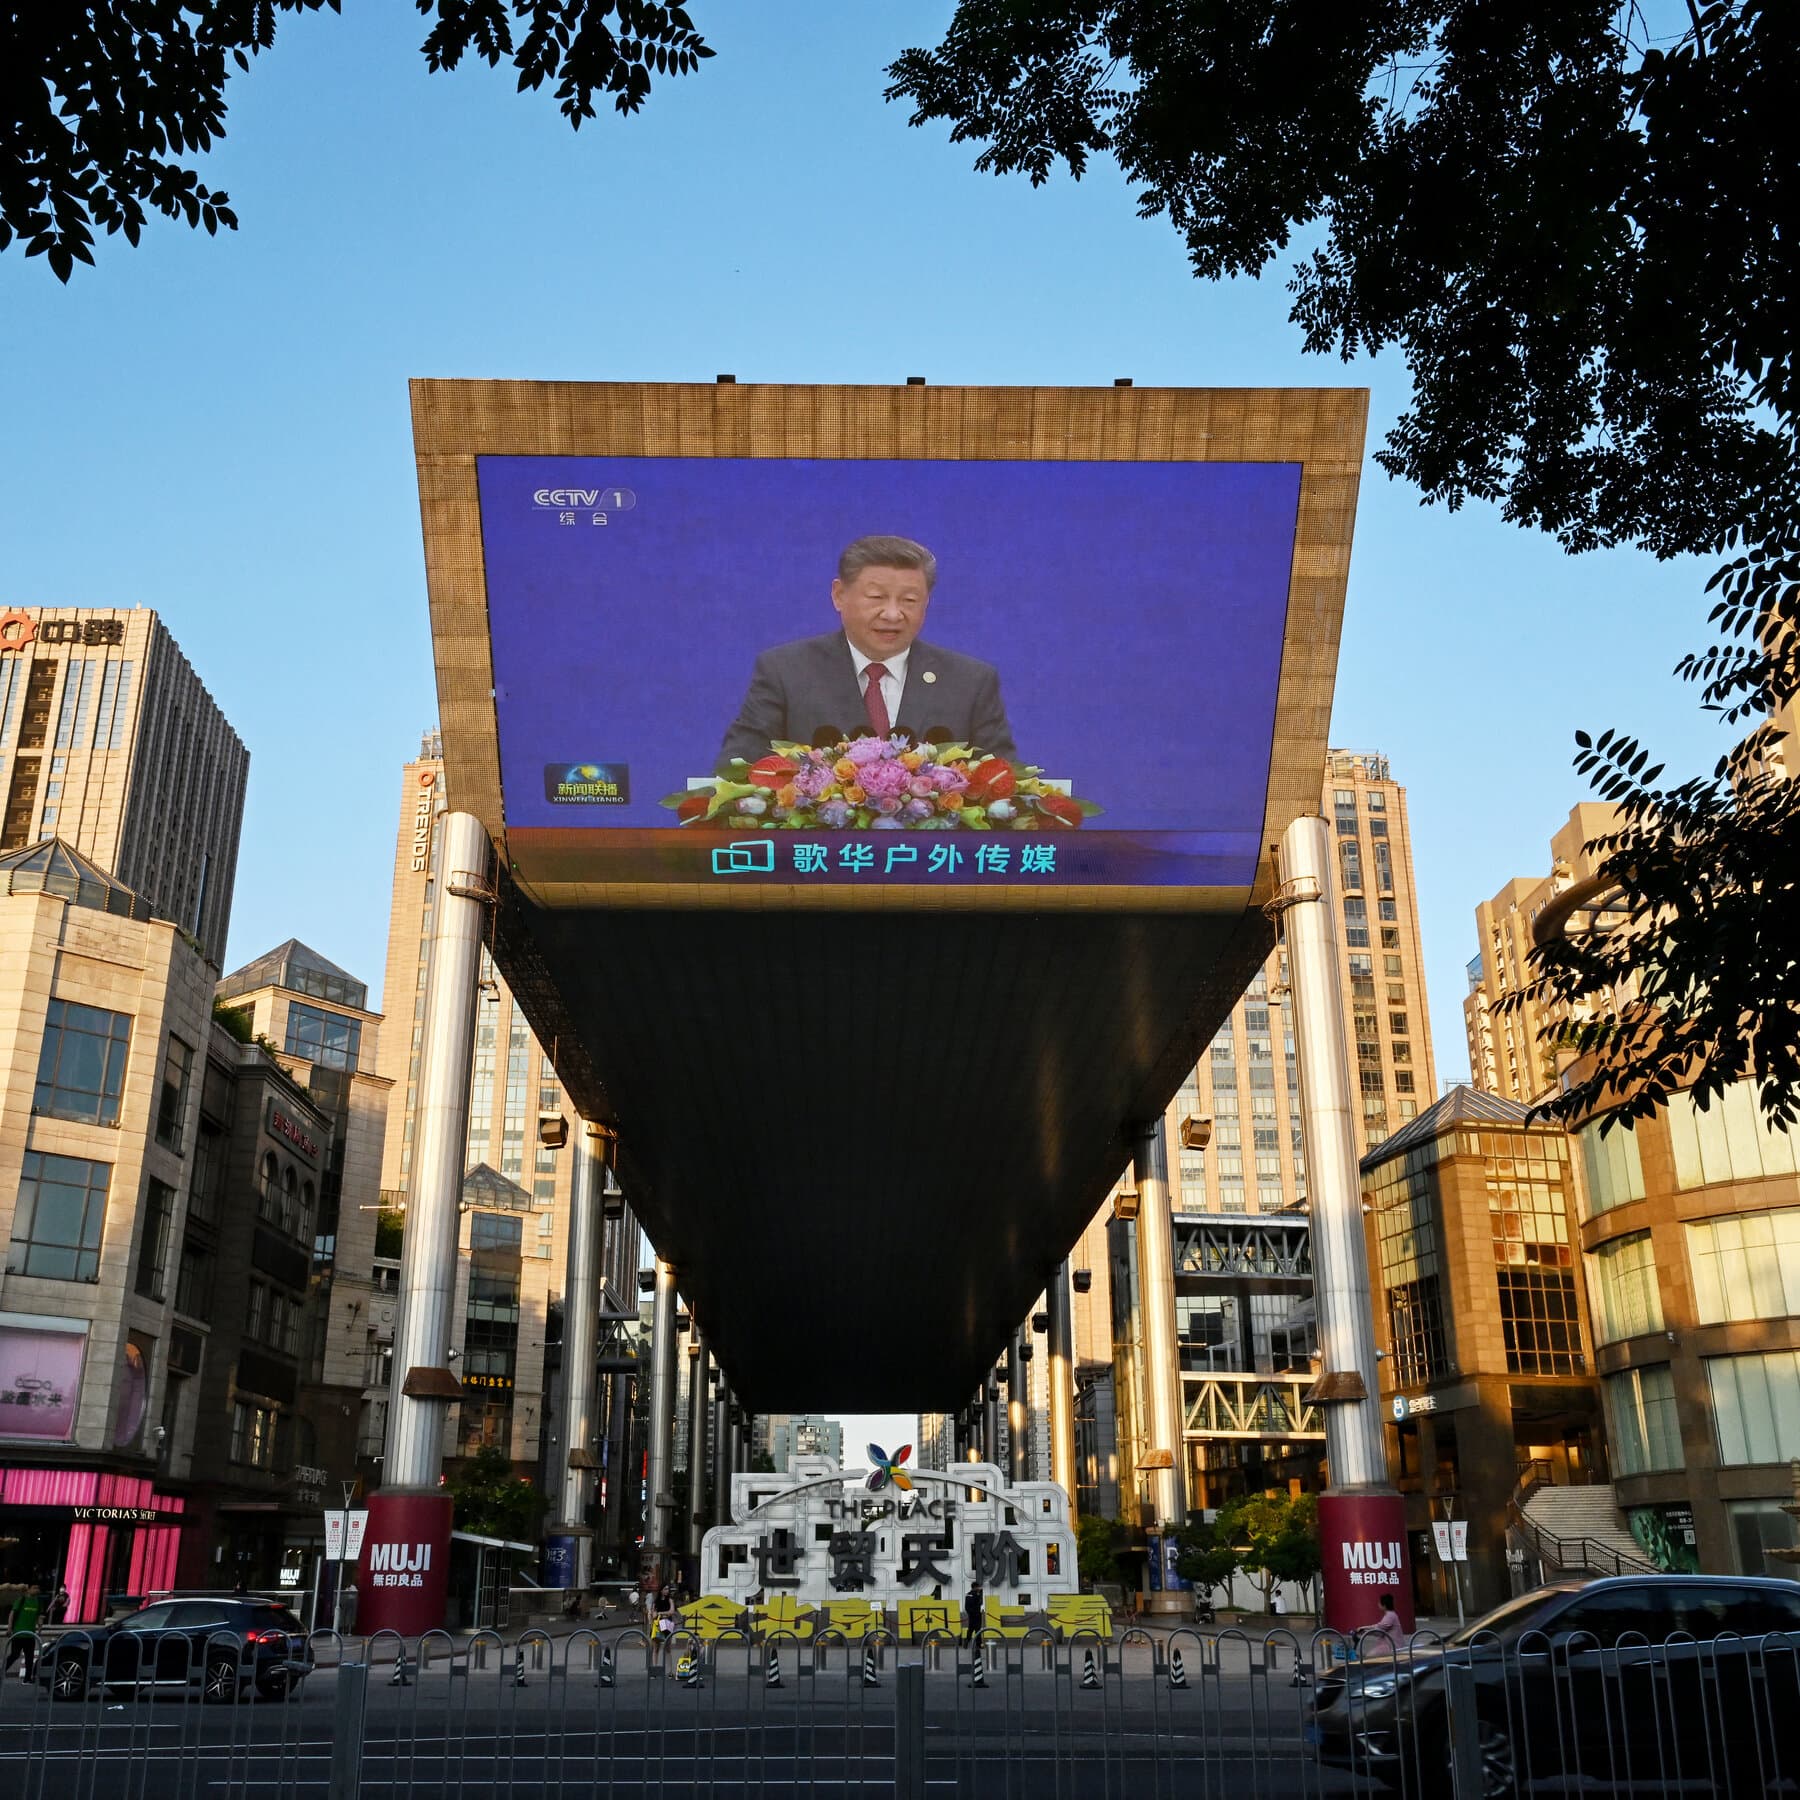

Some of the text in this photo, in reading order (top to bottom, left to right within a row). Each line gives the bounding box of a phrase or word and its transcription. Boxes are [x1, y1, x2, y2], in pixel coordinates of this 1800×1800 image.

[533, 489, 622, 508] CCTV 1
[559, 511, 608, 526] 综合
[557, 783, 618, 796] 新闻联播
[410, 788, 432, 872] TRENDS
[792, 843, 1057, 874] 歌华户外传媒
[73, 1507, 138, 1519] VICTORIA'S
[823, 1498, 957, 1520] THE PLACE
[369, 1543, 432, 1571] MUJI
[751, 1530, 1027, 1588] 世贸天阶
[1341, 1541, 1402, 1569] MUJI
[279, 1568, 301, 1580] MUJI
[372, 1573, 423, 1587] 無印良品
[1349, 1571, 1400, 1585] 無印良品
